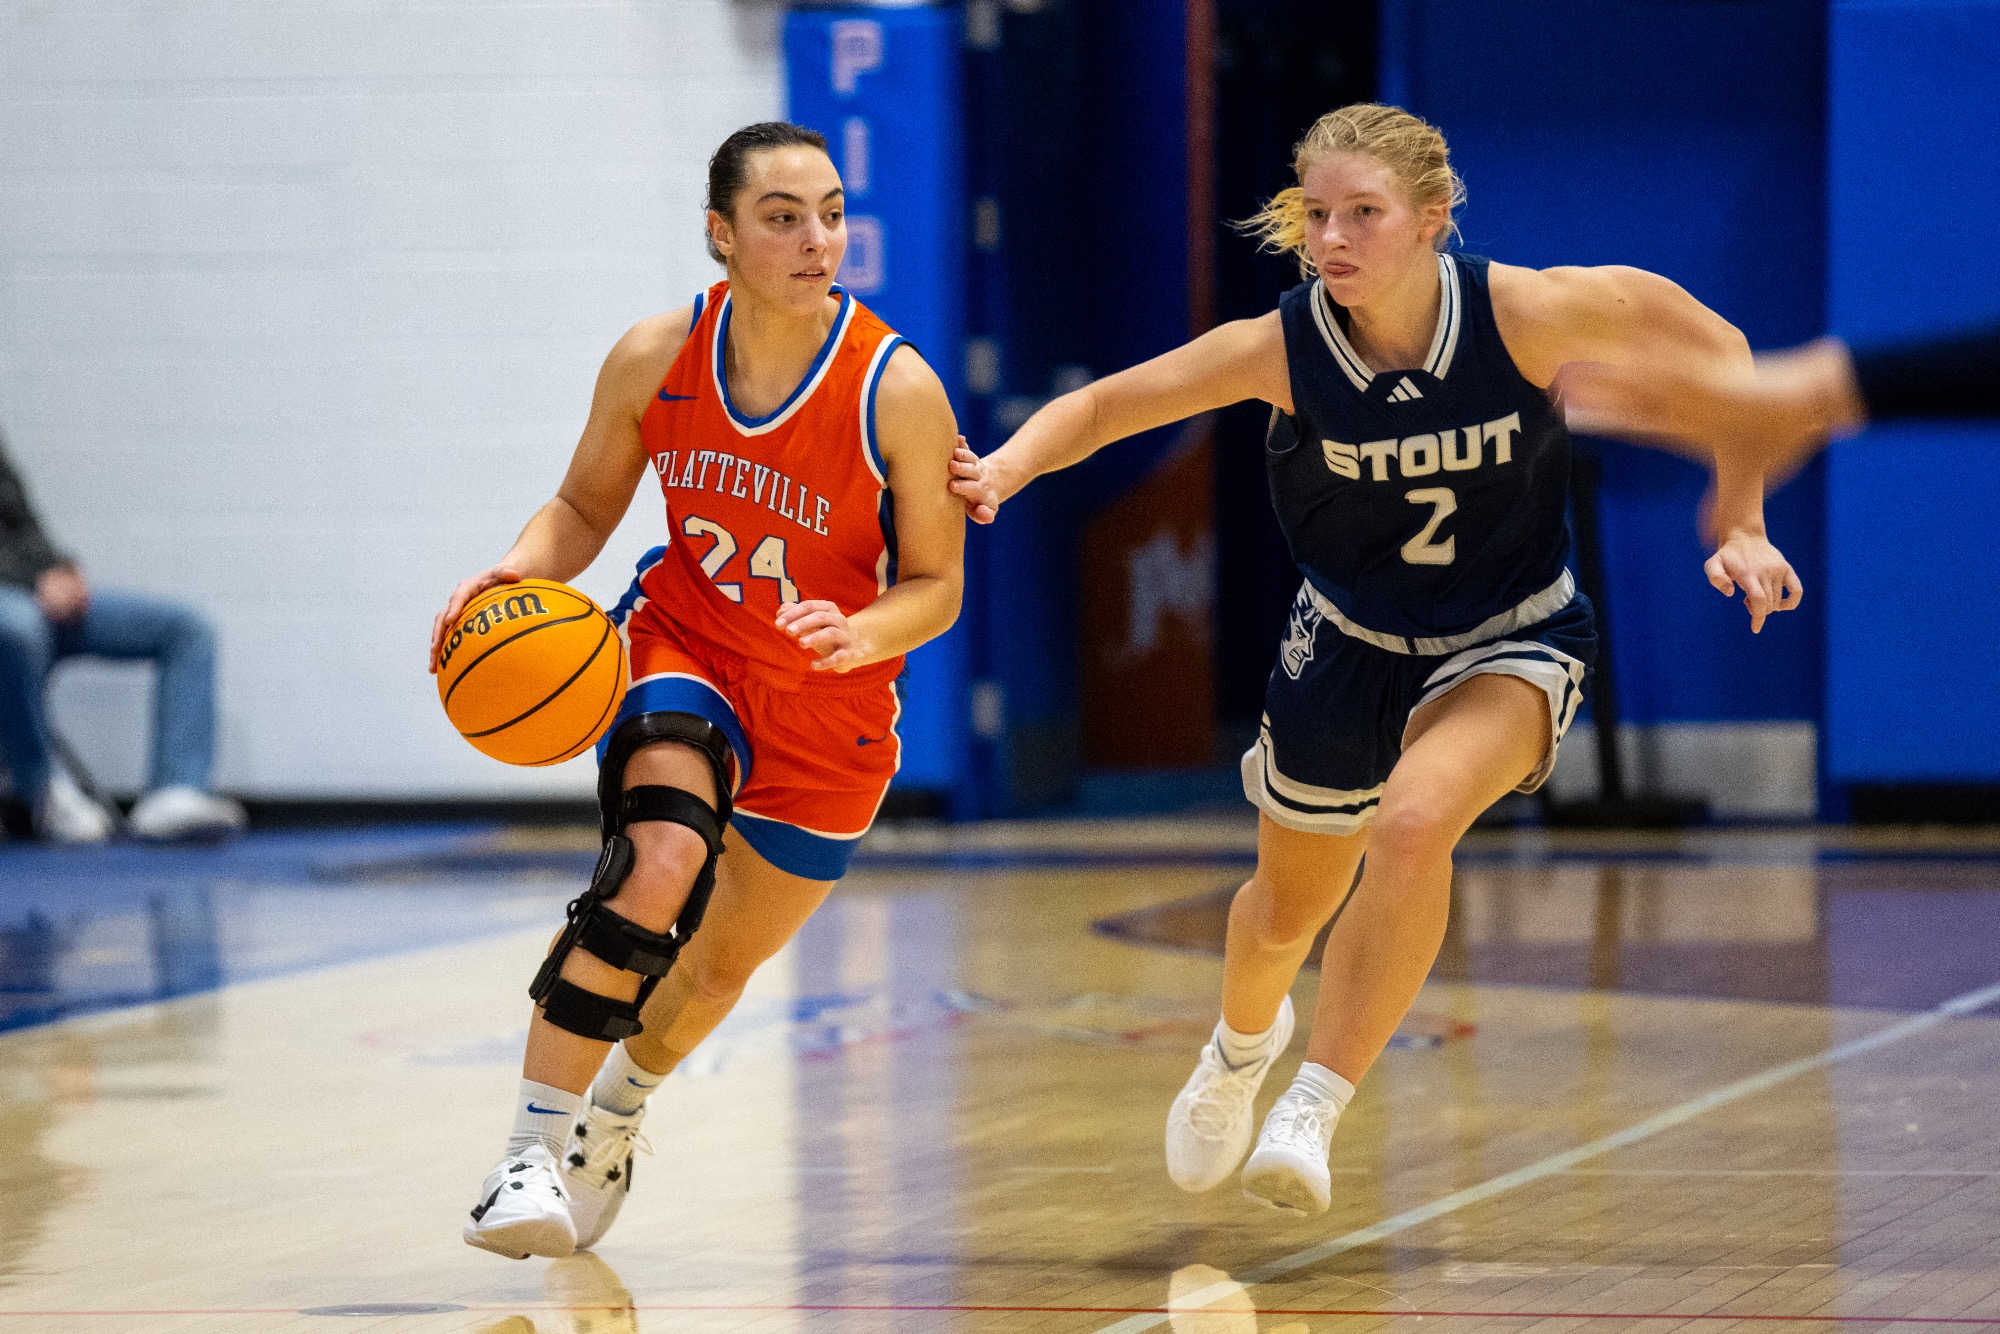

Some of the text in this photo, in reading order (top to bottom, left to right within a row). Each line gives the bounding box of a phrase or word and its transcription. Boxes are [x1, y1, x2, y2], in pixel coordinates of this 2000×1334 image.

[1321, 411, 1521, 481] STOUT
[656, 450, 831, 537] PLATTEVILLE
[1400, 487, 1457, 565] 2
[682, 514, 800, 604] 24
[439, 592, 549, 670] Wilson
